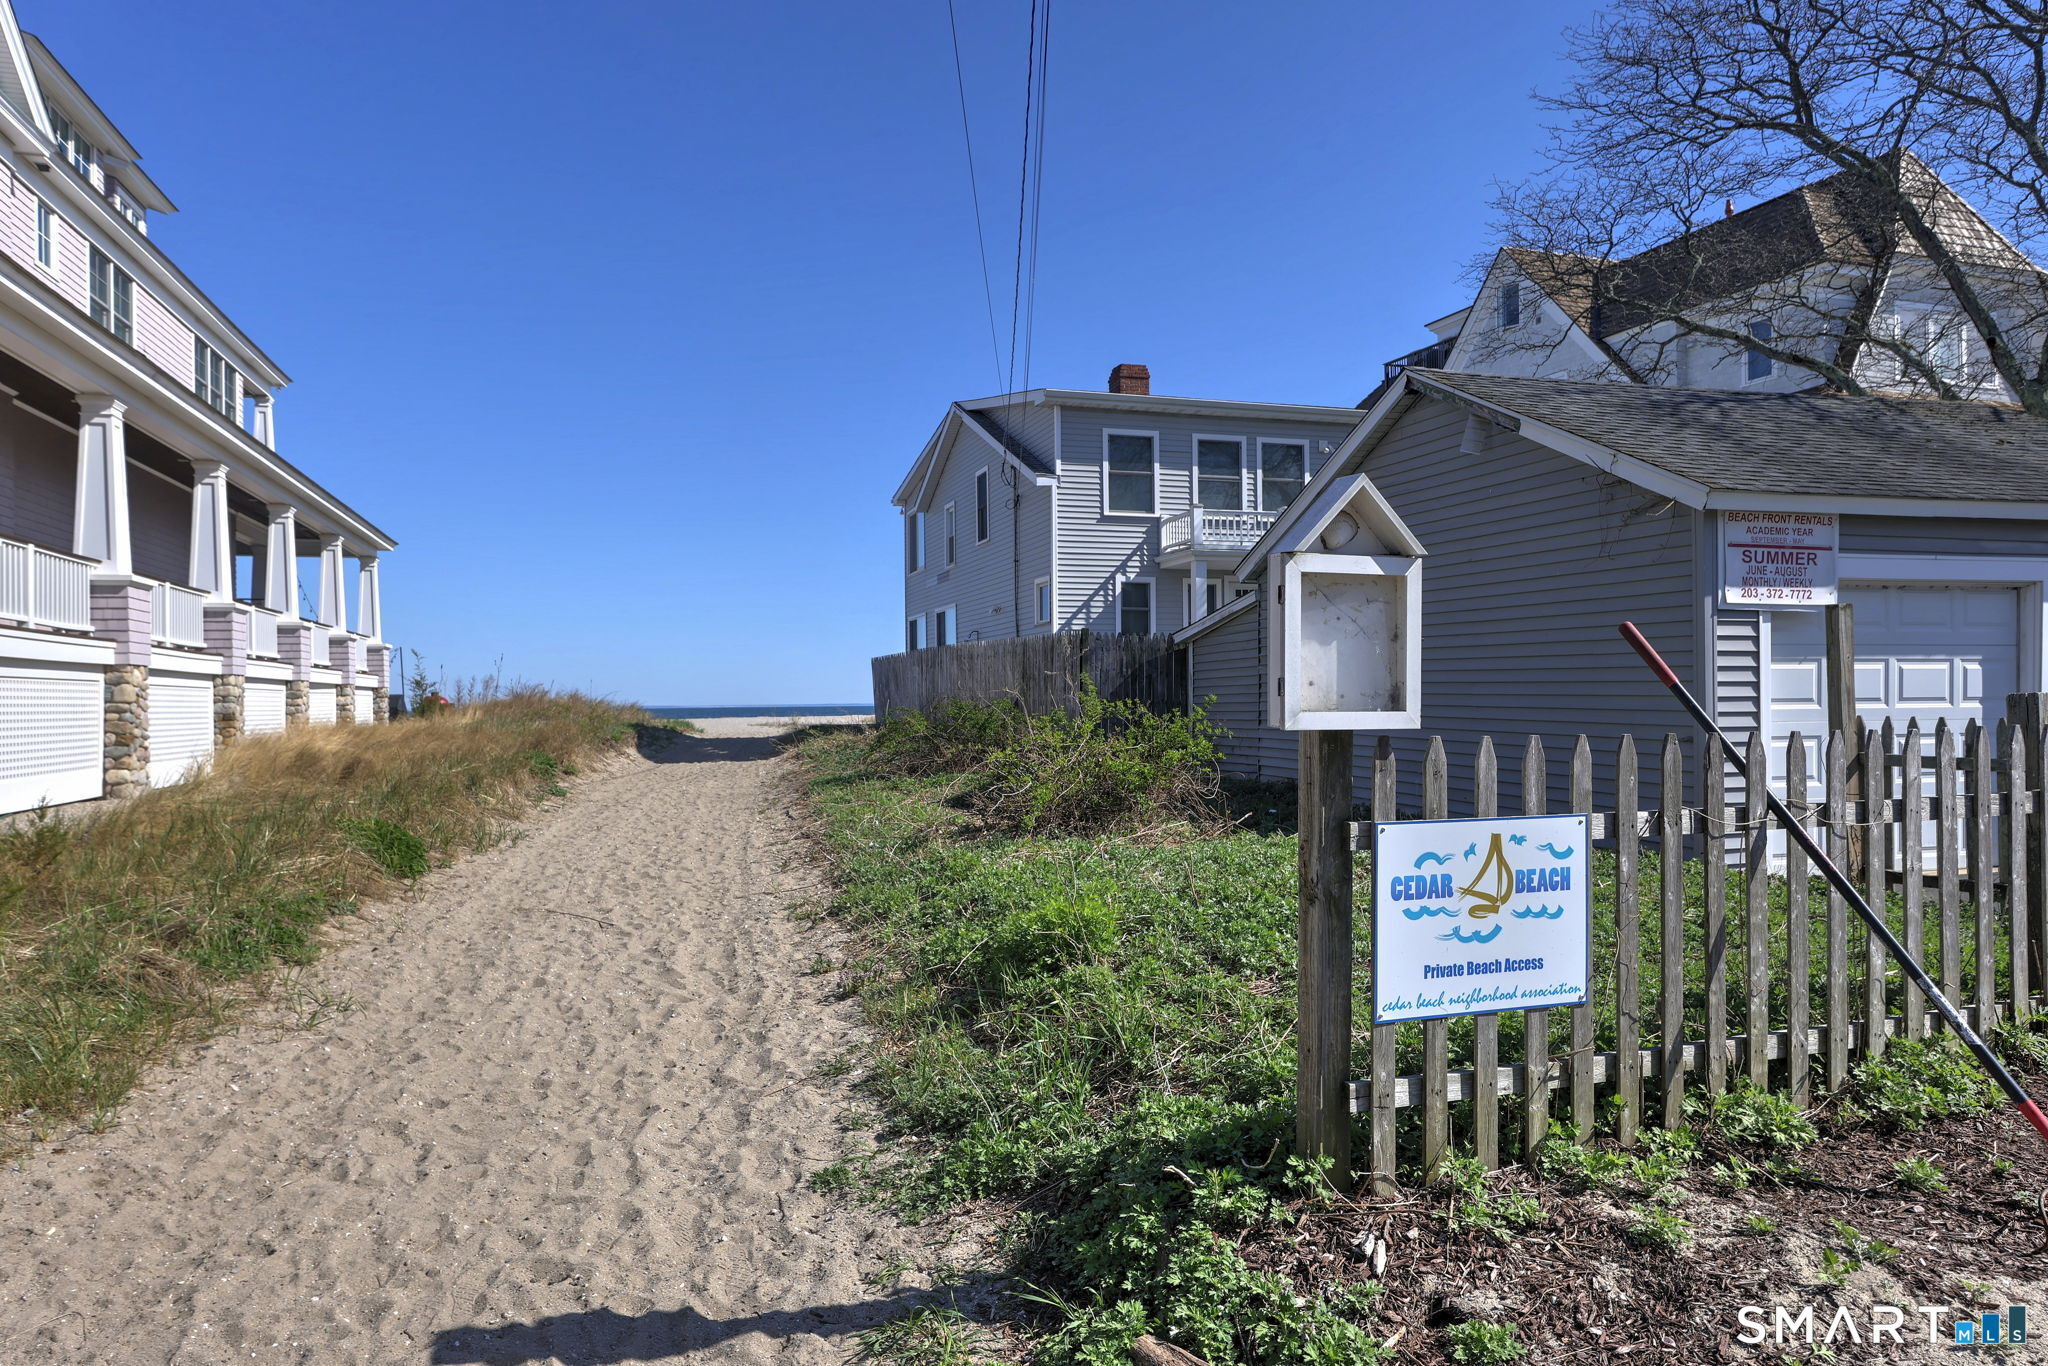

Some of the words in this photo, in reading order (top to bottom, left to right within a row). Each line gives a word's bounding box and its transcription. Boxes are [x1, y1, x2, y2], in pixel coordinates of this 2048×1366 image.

[1728, 512, 1760, 522] BEACH
[1762, 514, 1792, 524] FRONT
[1795, 516, 1832, 526] RENTALS
[1746, 526, 1789, 536] ACADEMIC
[1792, 528, 1814, 536] YEAR
[1742, 550, 1817, 566] SUMMER
[1746, 565, 1768, 575] JUNE
[1774, 566, 1808, 577] AUGUST
[1742, 576, 1777, 587] MONTHLY
[1783, 578, 1812, 588] WEEKLY
[1390, 873, 1454, 901] CEDAR
[1514, 866, 1570, 894] BEACH
[1424, 964, 1464, 980] Private
[1466, 960, 1502, 976] Beach
[1504, 957, 1544, 972] Access
[1382, 994, 1412, 1012] cedar
[1416, 990, 1445, 1007] beach
[1449, 985, 1518, 1010] neighborhood
[1521, 982, 1582, 998] association
